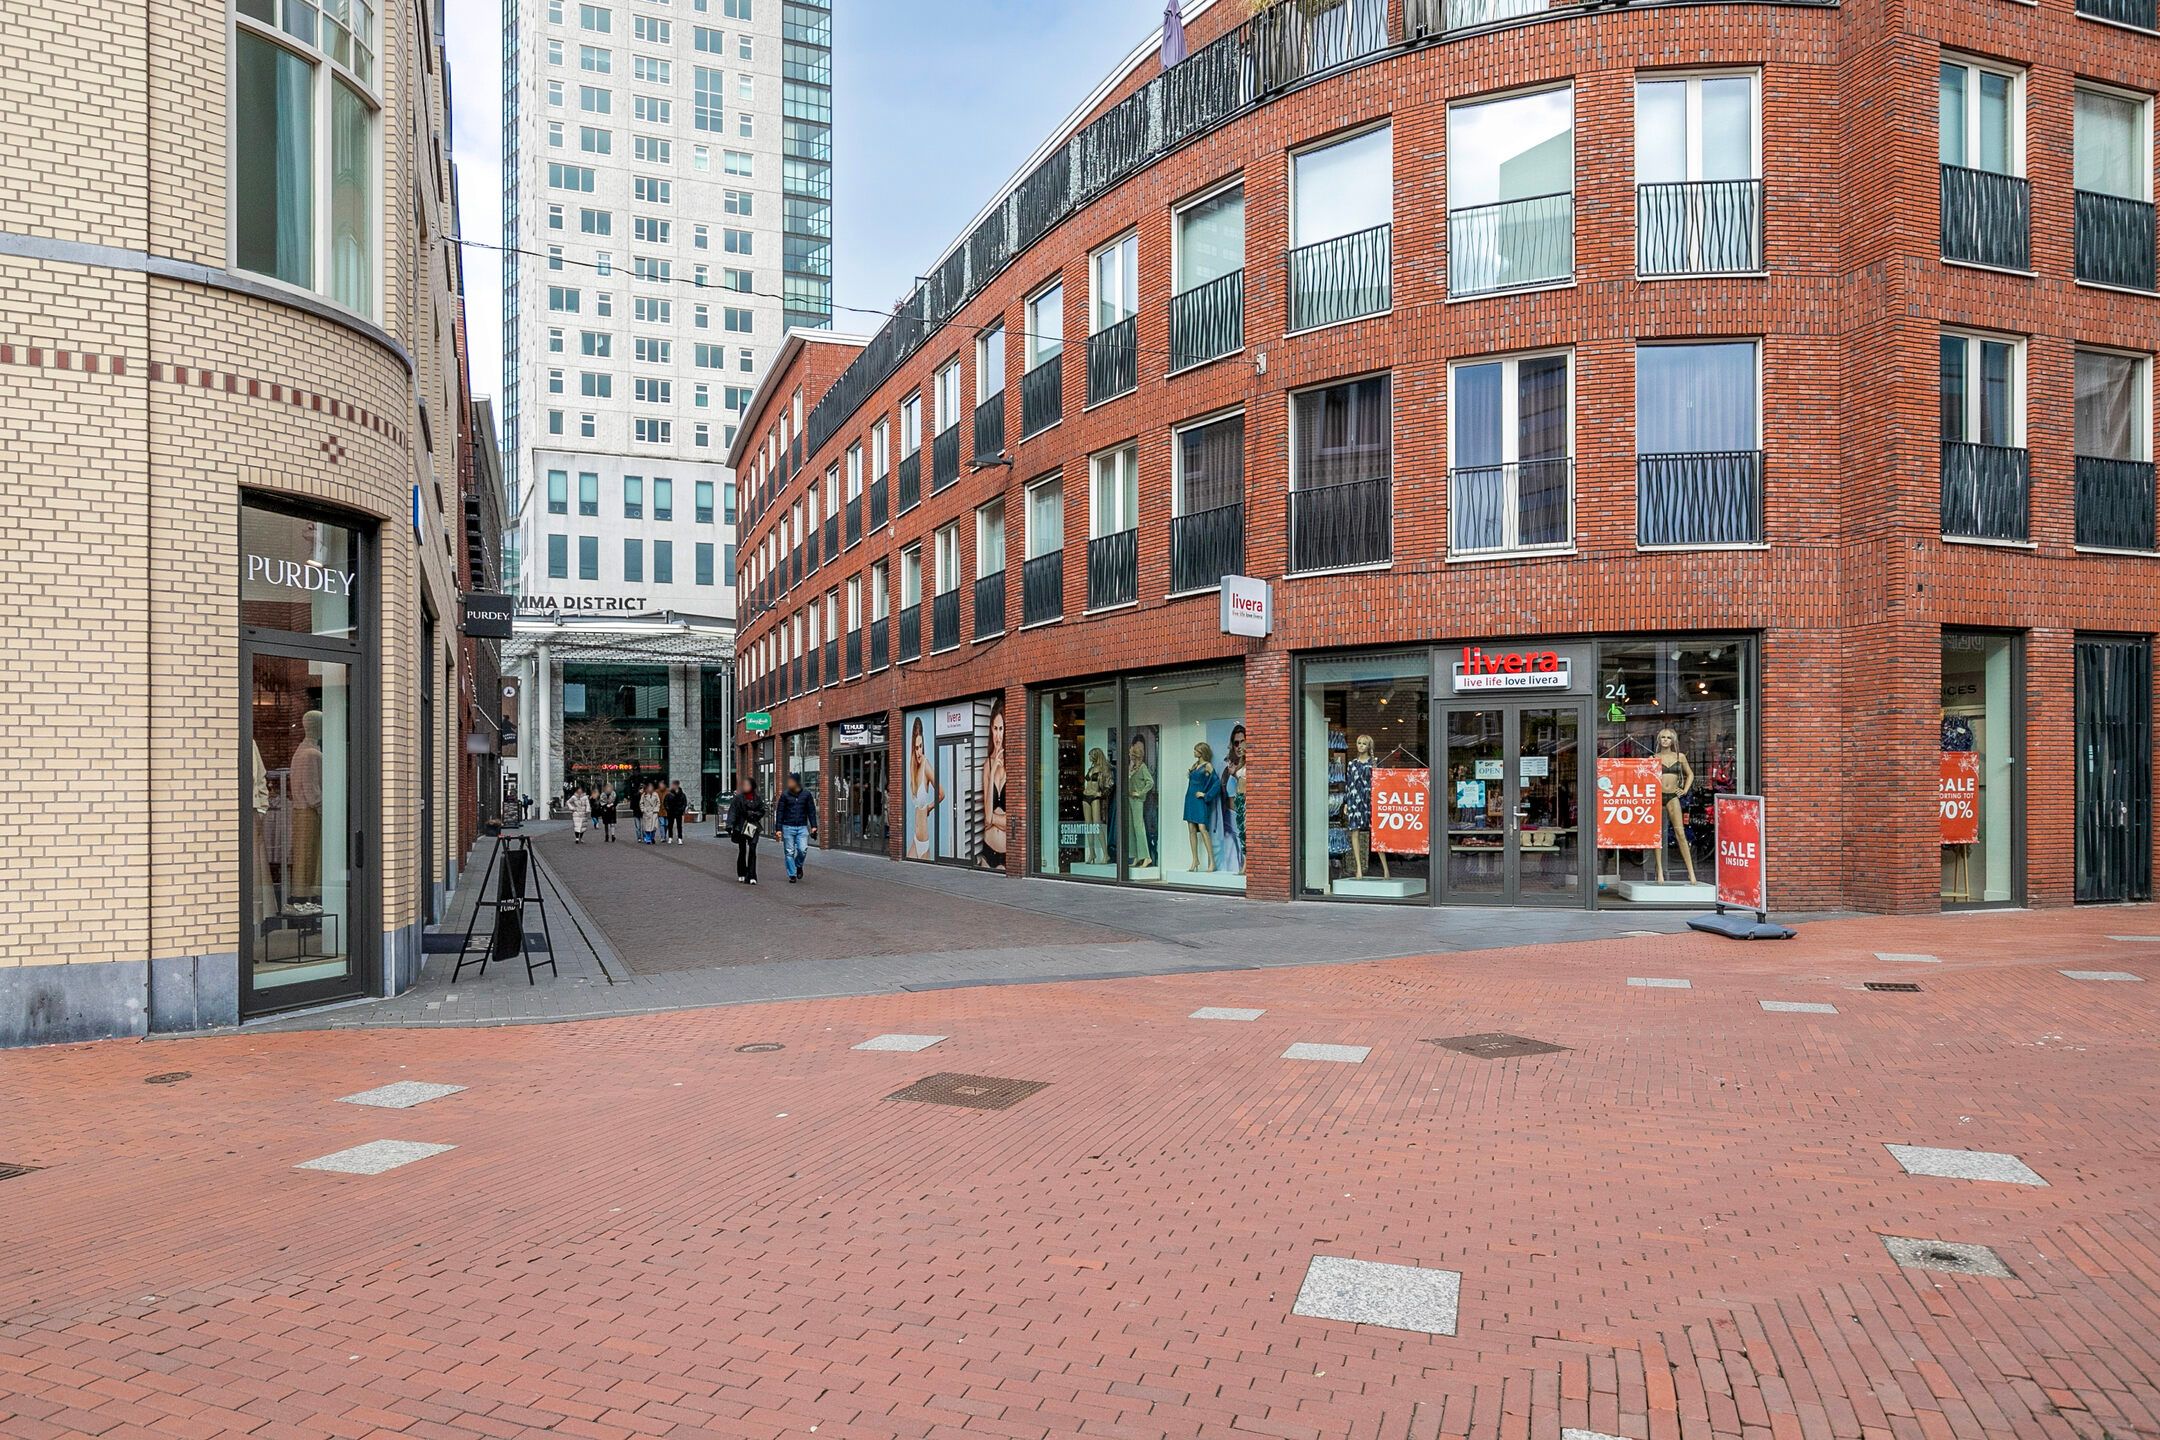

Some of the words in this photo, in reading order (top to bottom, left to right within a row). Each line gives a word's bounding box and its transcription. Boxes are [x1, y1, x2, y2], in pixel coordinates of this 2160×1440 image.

[247, 554, 355, 596] PURDEY
[564, 596, 647, 610] DISTRICT
[1232, 592, 1263, 612] livera
[1462, 647, 1559, 676] livera
[1463, 678, 1482, 687] live
[1485, 677, 1502, 687] life
[1505, 677, 1526, 686] love
[1529, 675, 1558, 685] livera
[1605, 684, 1627, 699] 24
[1479, 767, 1500, 775] OPEN
[1377, 791, 1424, 805] SALE
[1377, 812, 1423, 830] 70%
[1603, 806, 1655, 824] 70%
[1721, 840, 1755, 859] SALE
[1725, 857, 1749, 867] INSIDE
